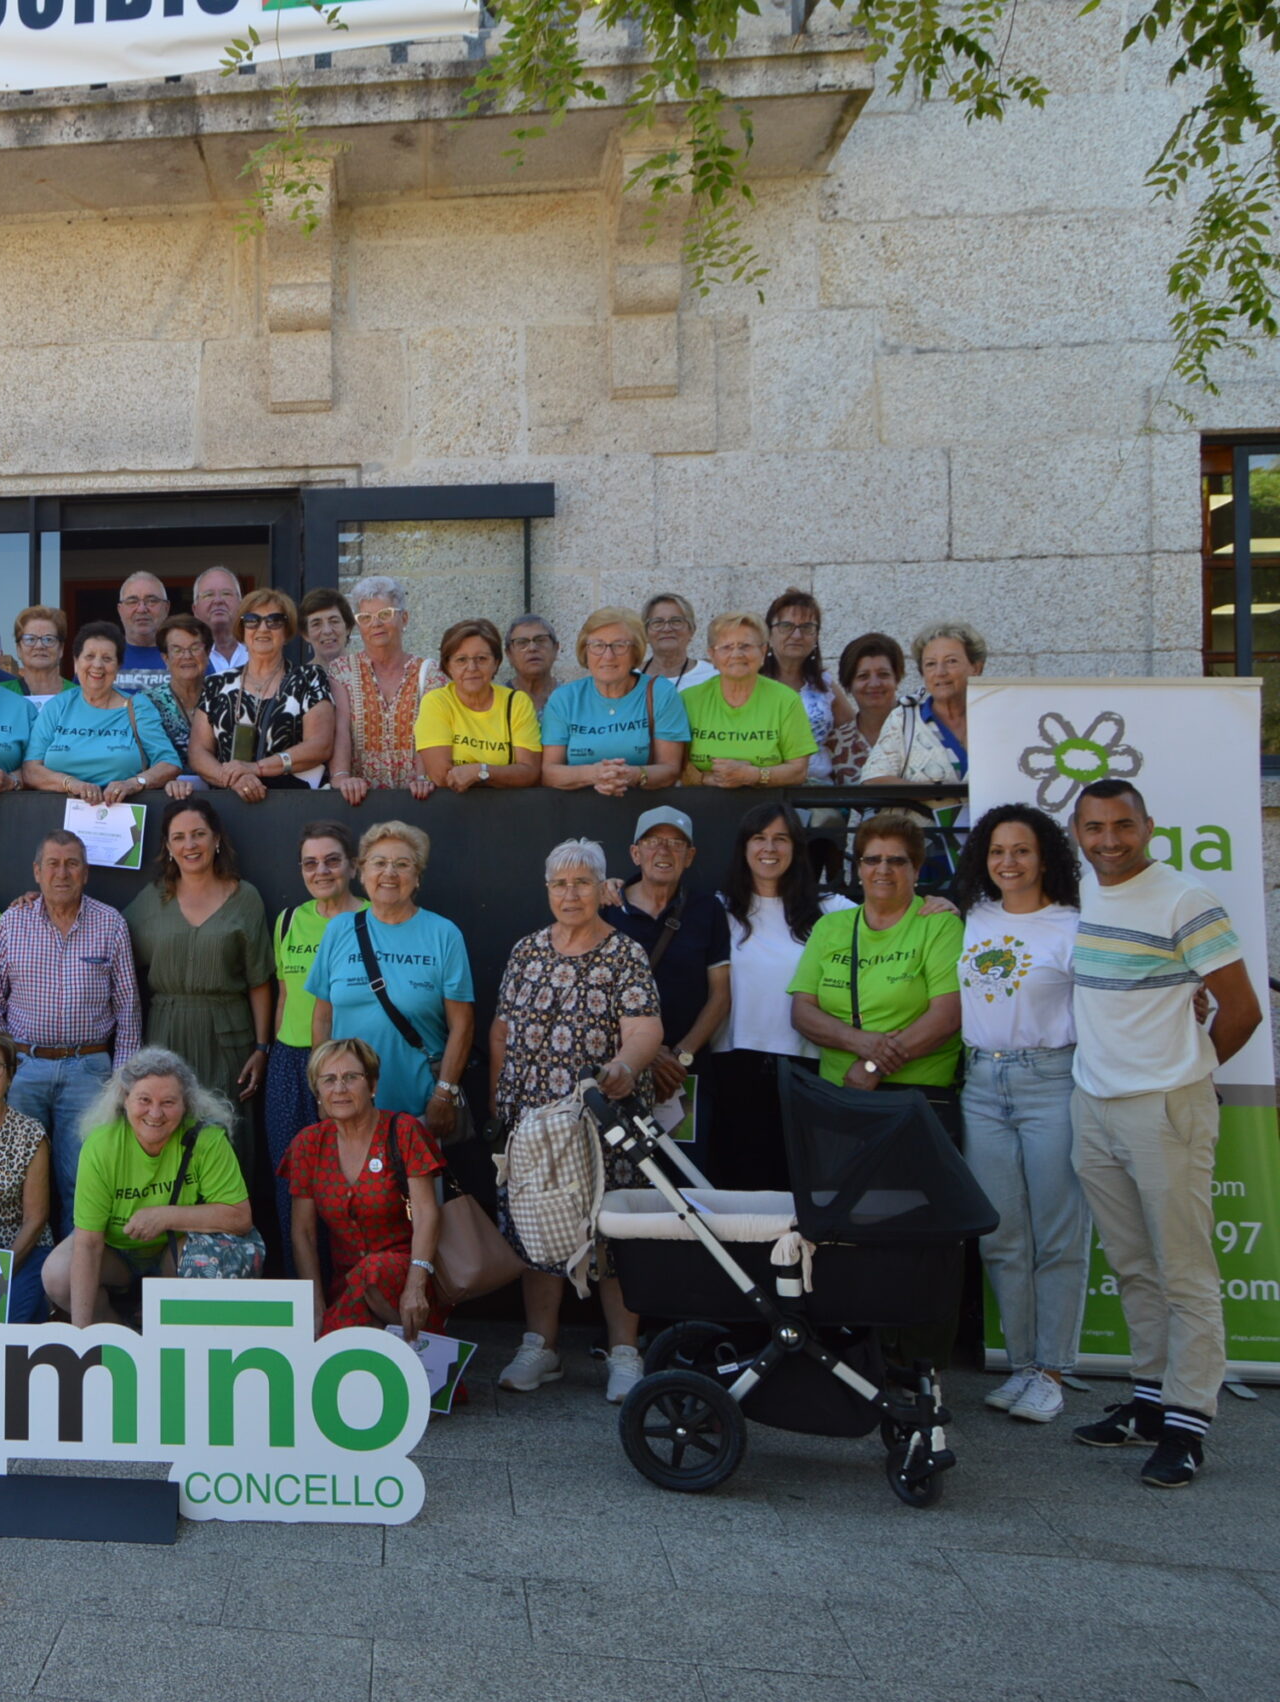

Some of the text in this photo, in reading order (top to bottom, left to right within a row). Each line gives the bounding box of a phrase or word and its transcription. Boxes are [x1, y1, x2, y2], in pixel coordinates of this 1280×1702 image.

[691, 730, 778, 742] REACTIVATE!
[348, 951, 436, 967] RECTIVATE!
[184, 1471, 405, 1508] CONCELLO
